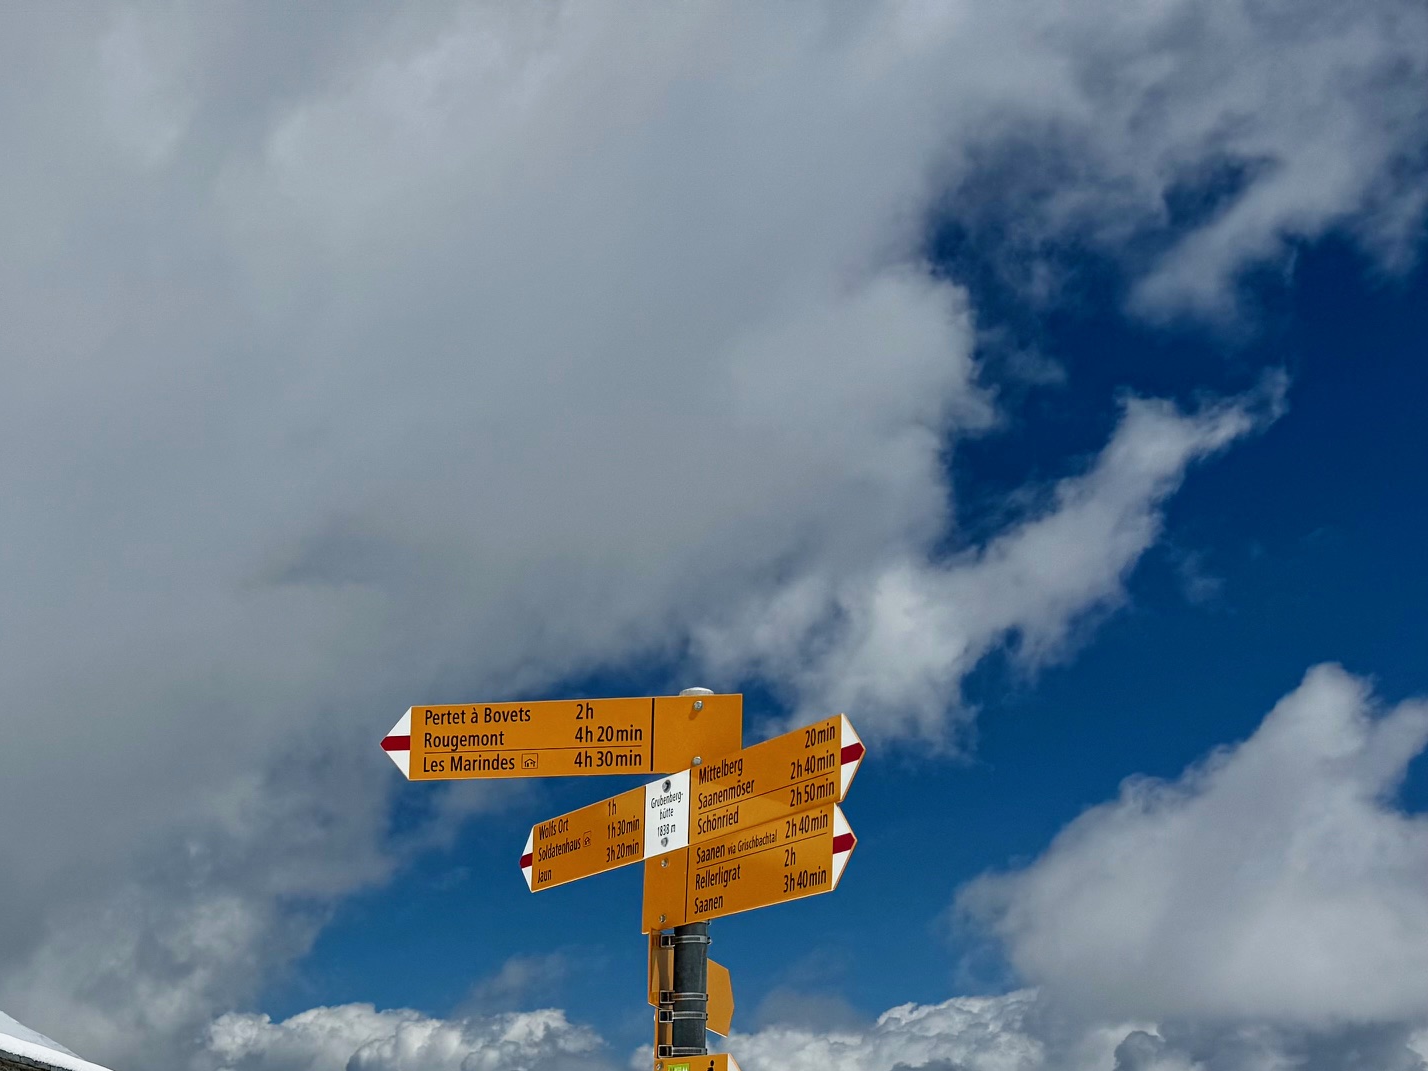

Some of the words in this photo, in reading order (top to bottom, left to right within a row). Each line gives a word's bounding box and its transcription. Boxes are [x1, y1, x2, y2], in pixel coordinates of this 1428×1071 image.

[425, 709, 466, 726] Pertet
[470, 707, 479, 724] à
[483, 706, 532, 723] Bovets
[424, 730, 505, 752] Rougemont
[423, 756, 445, 773] Les
[450, 753, 516, 772] Marindes
[698, 758, 743, 786] Mittelberg
[698, 778, 755, 810] Saanenmöser
[538, 820, 557, 841] Wolfs
[558, 818, 569, 832] Ort
[697, 805, 739, 835] Schönried
[538, 836, 581, 862] Soldatenhaus
[696, 843, 726, 865] Saanen
[727, 842, 736, 855] via
[737, 829, 778, 853] Grischbachtal
[537, 869, 552, 884] Jaun
[695, 864, 741, 891] Rellerligrat
[694, 894, 724, 915] Saanen
